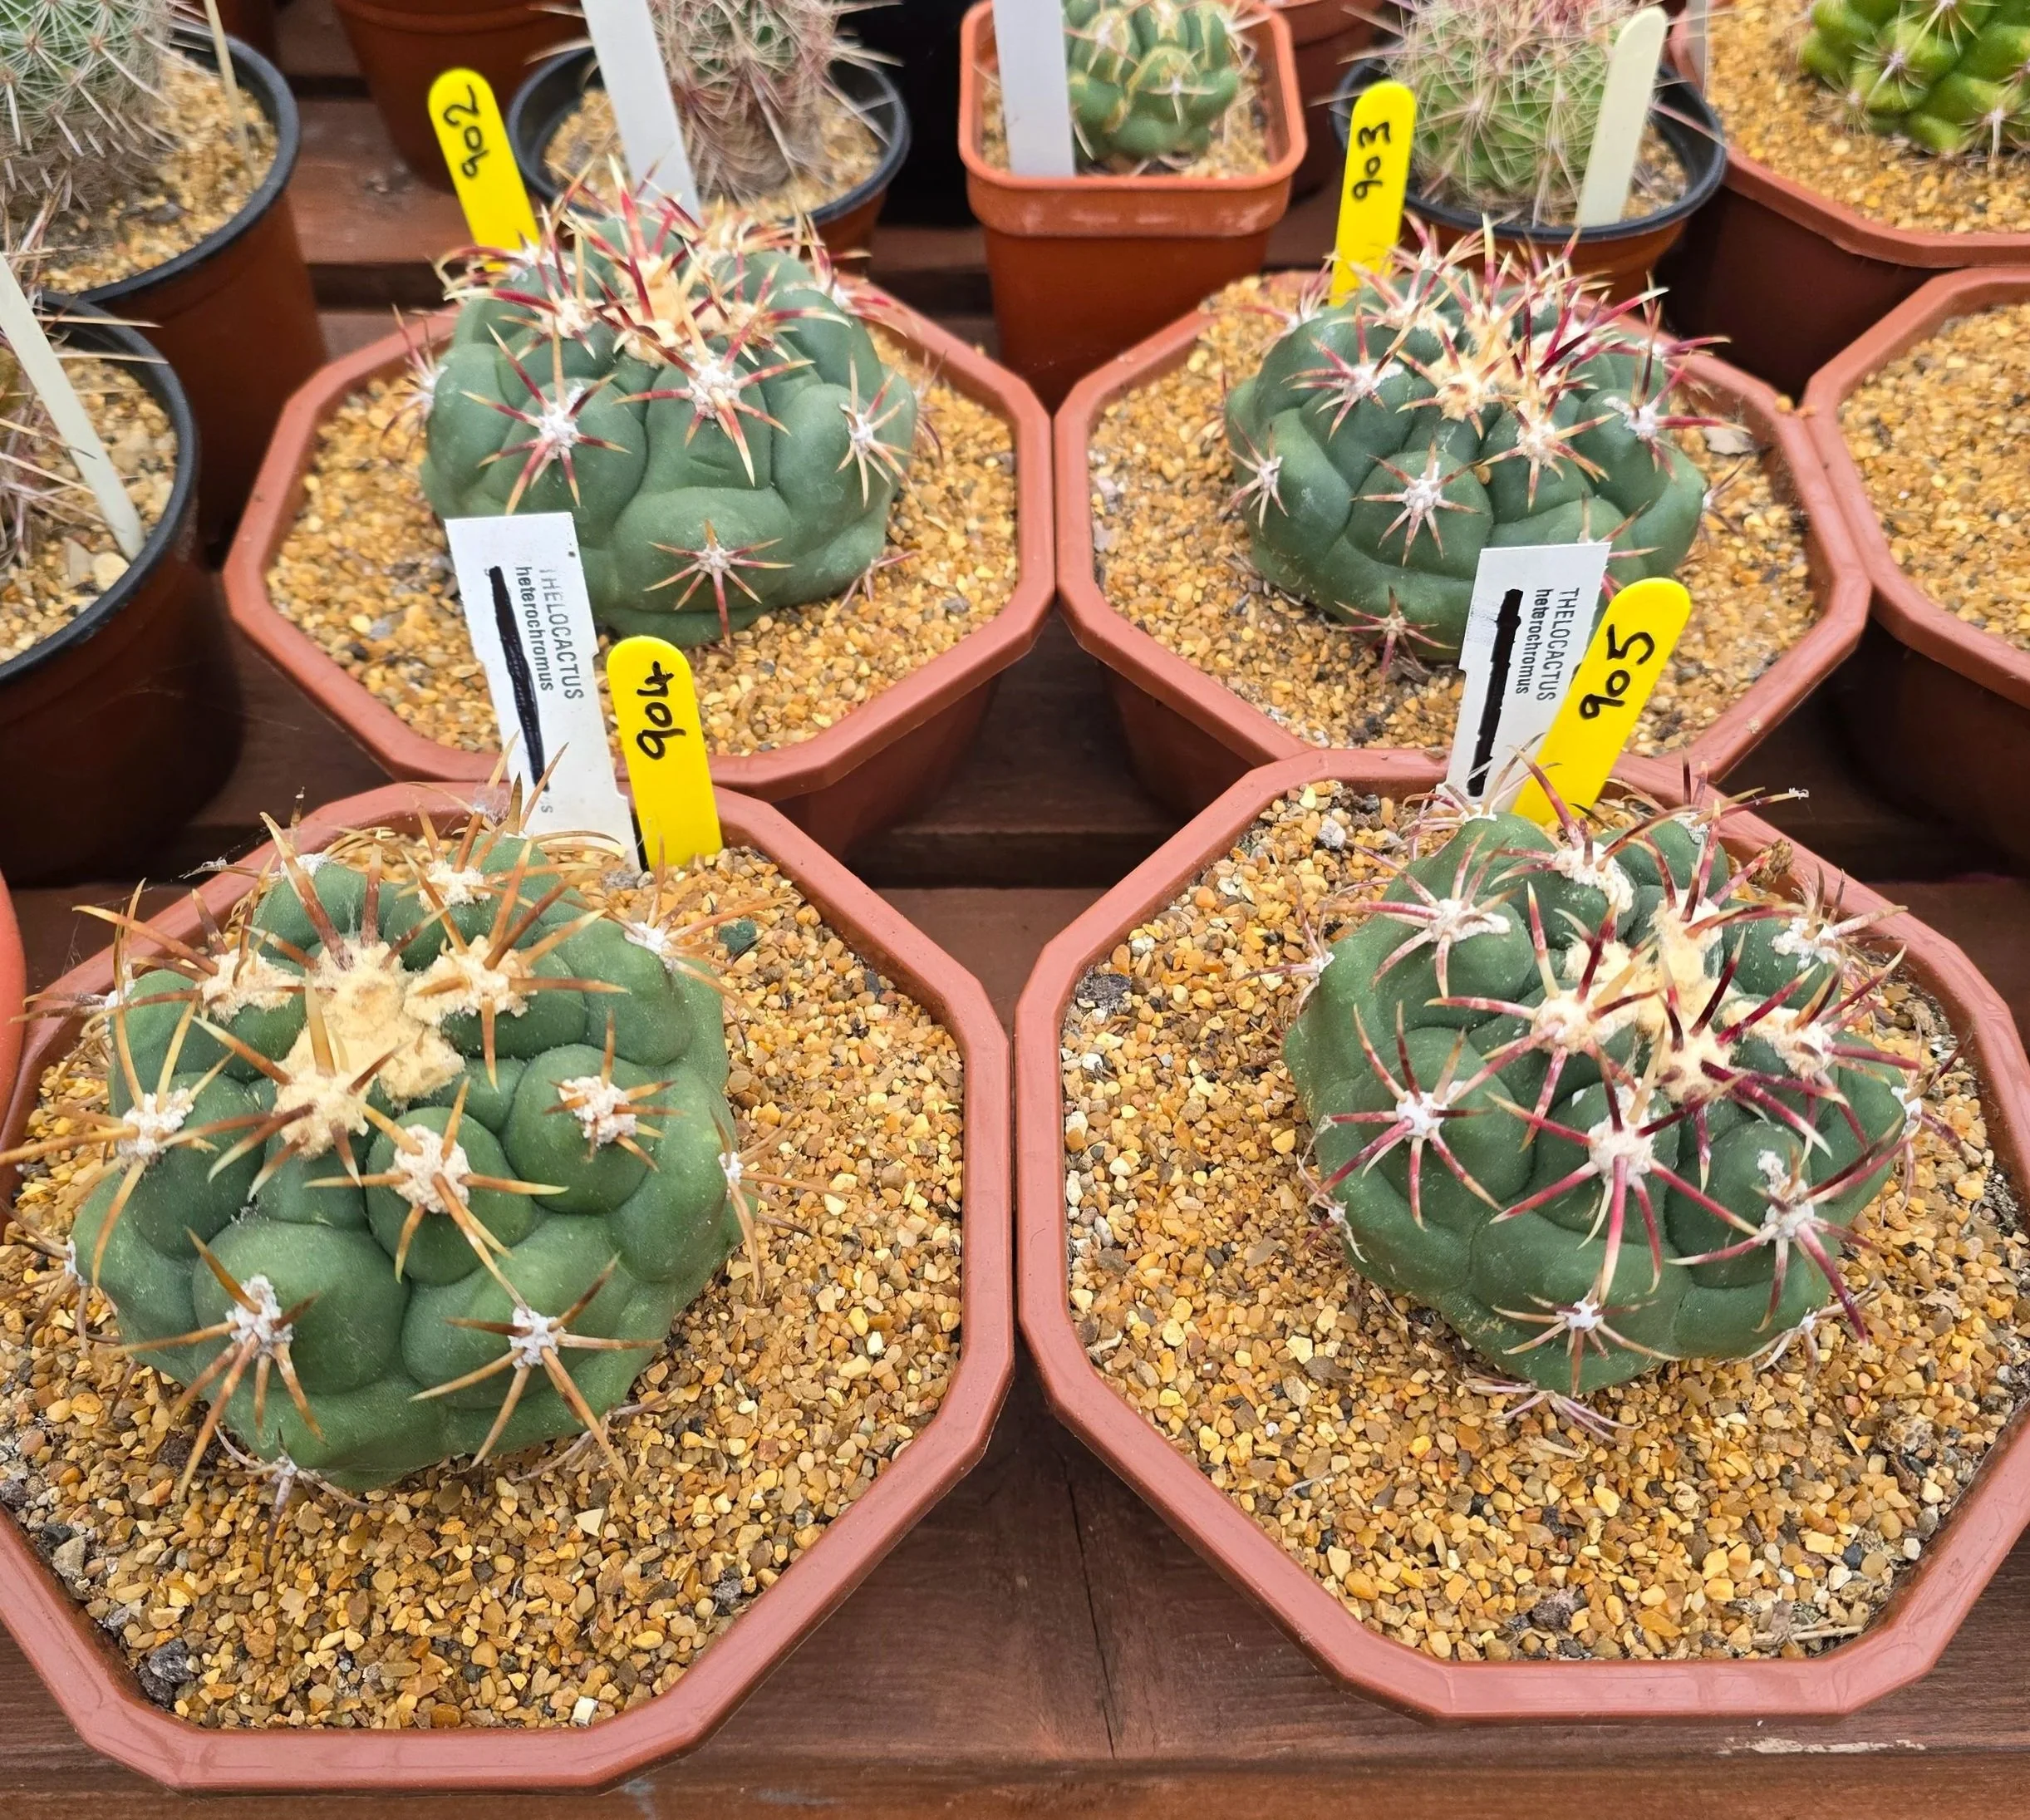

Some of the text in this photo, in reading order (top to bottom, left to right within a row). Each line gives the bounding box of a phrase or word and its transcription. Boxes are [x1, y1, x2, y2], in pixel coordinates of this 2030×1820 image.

[443, 84, 489, 178] 902
[1353, 121, 1392, 201] 903
[515, 566, 553, 691] heterochromus
[1515, 588, 1554, 694] heterochromus
[1536, 588, 1580, 701] THELOCACTUS
[1579, 623, 1655, 720] 905
[637, 661, 686, 760] 904
